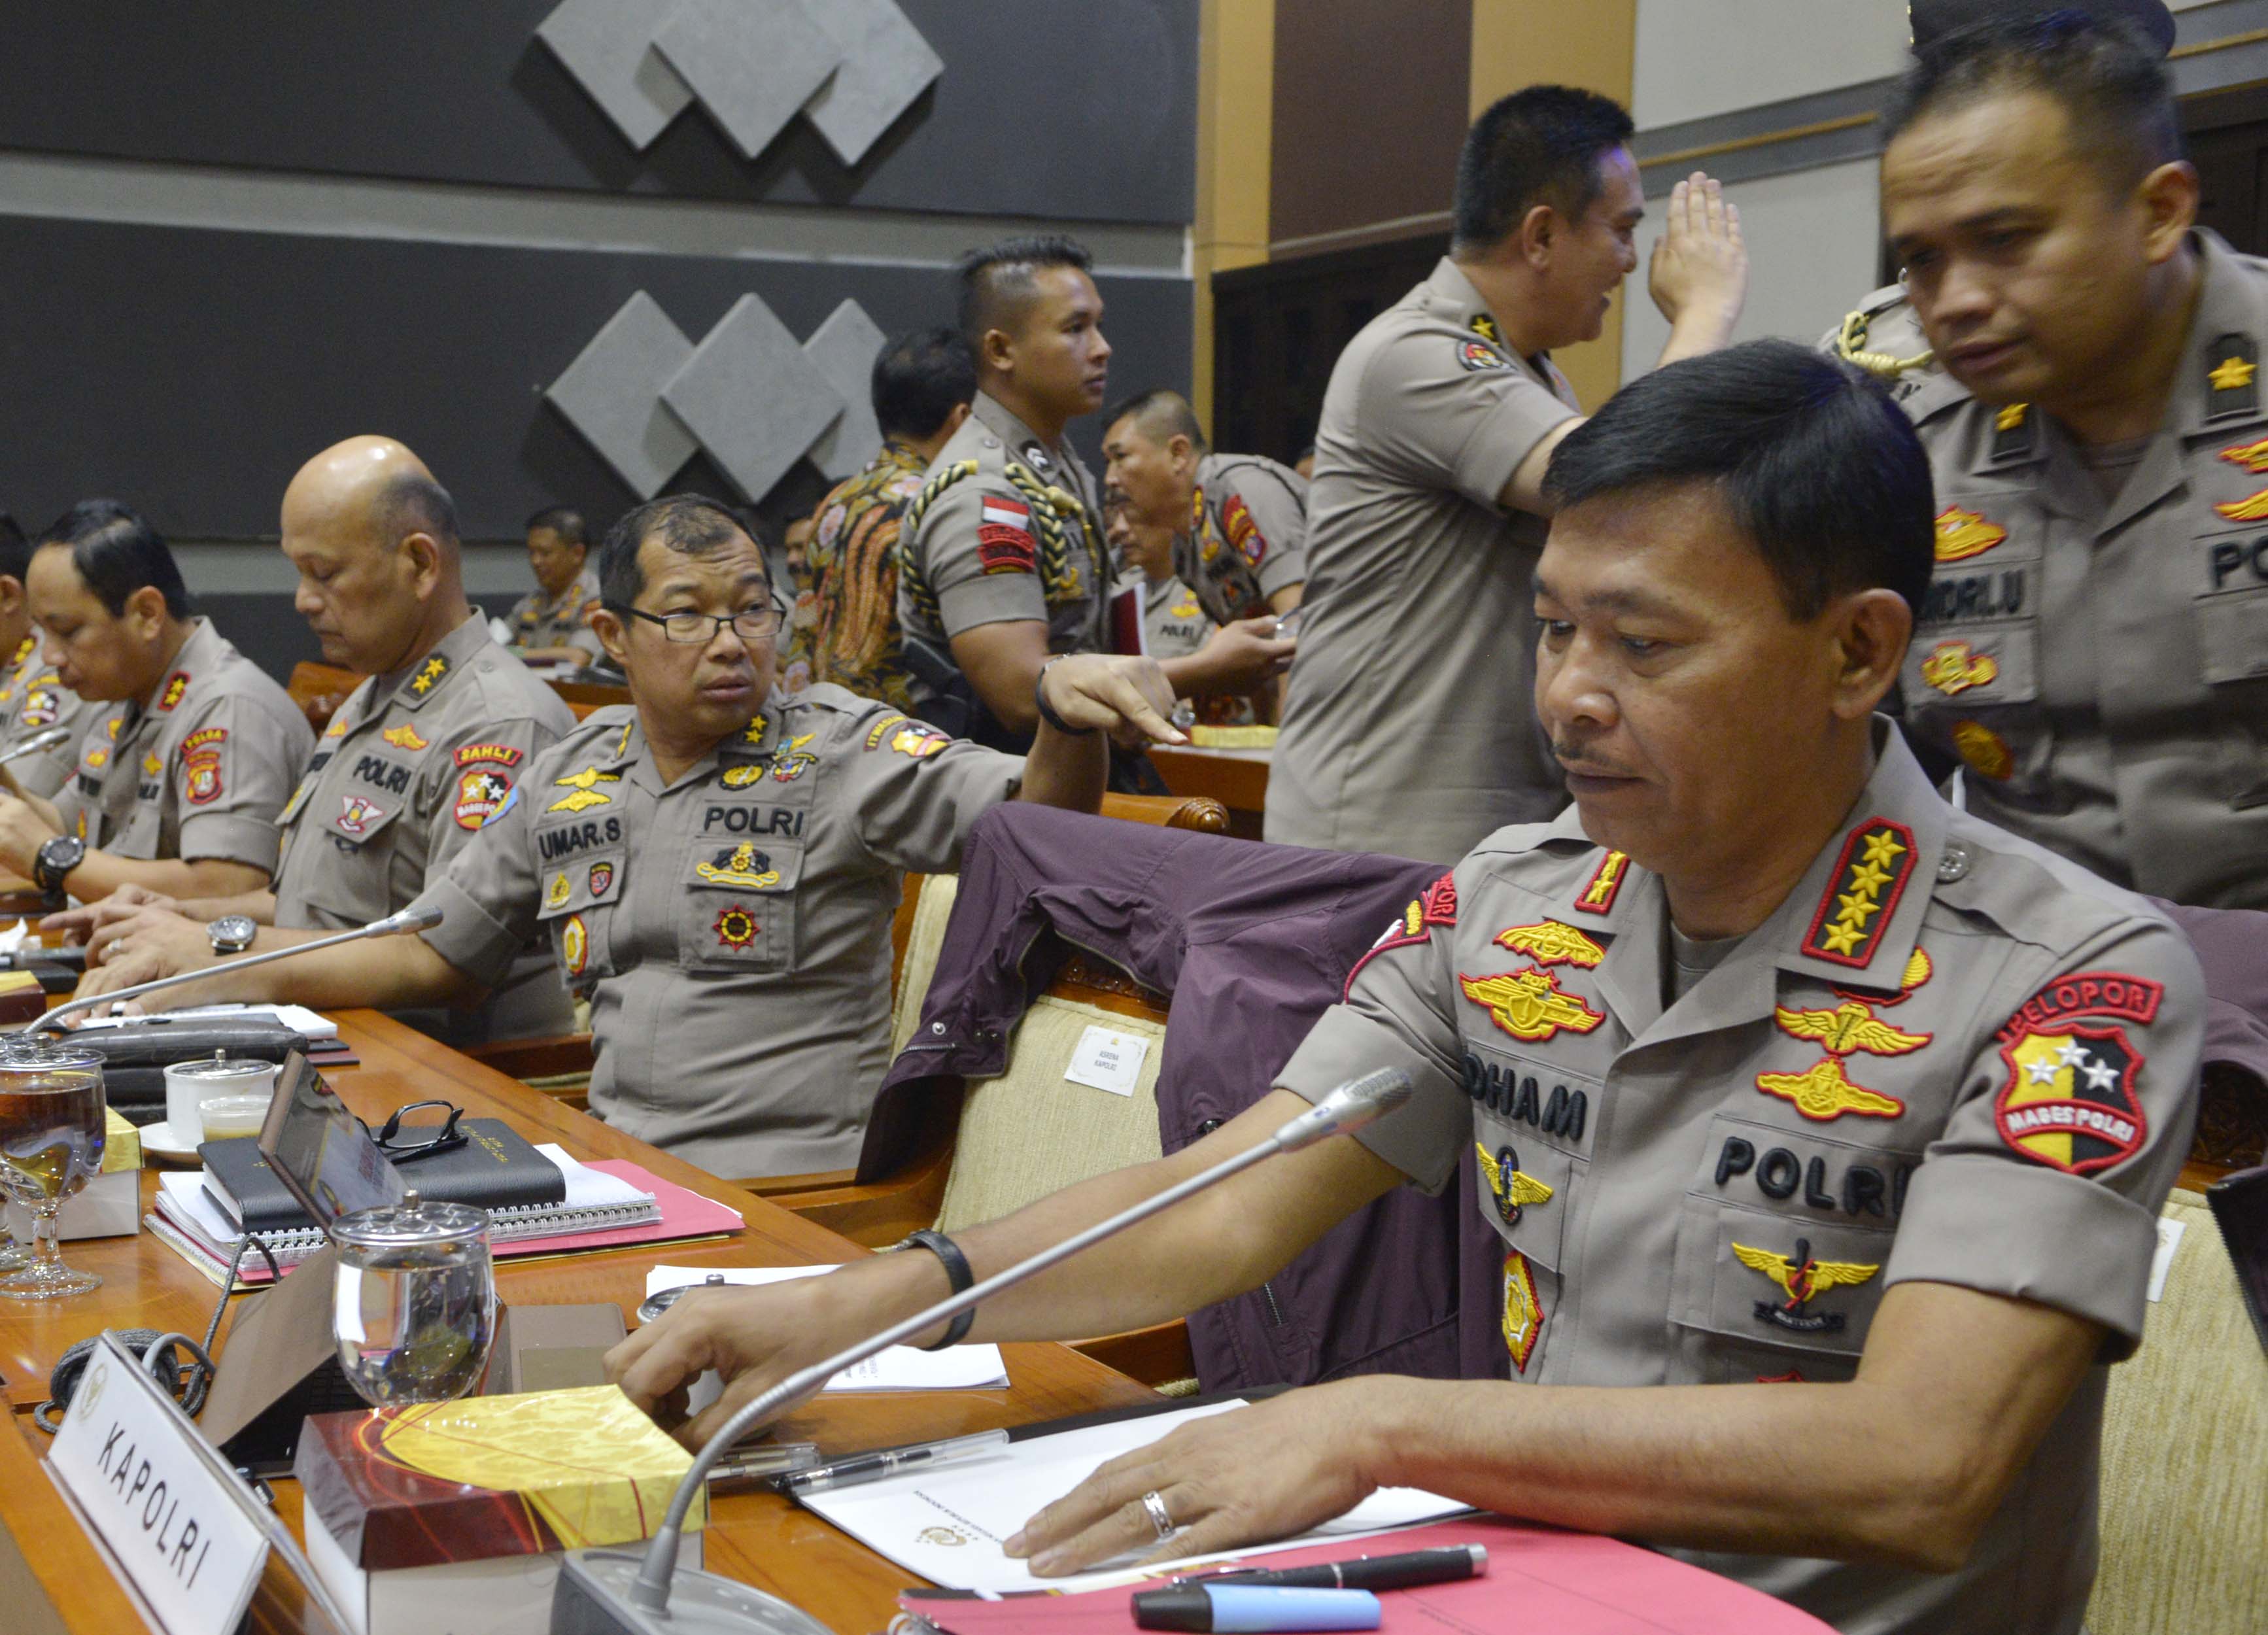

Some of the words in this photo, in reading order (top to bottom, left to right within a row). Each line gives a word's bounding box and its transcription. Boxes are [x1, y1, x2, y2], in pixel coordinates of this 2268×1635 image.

[460, 746, 513, 762] SAHLI
[352, 755, 411, 795] POLRI
[538, 817, 621, 860] UMAR.S
[704, 806, 804, 836] POLRI
[1462, 1052, 1588, 1142] DHAM
[2076, 1109, 2136, 1142] POLRI
[1715, 1135, 1912, 1216] POLRI
[97, 1421, 211, 1591] KAPOLRI
